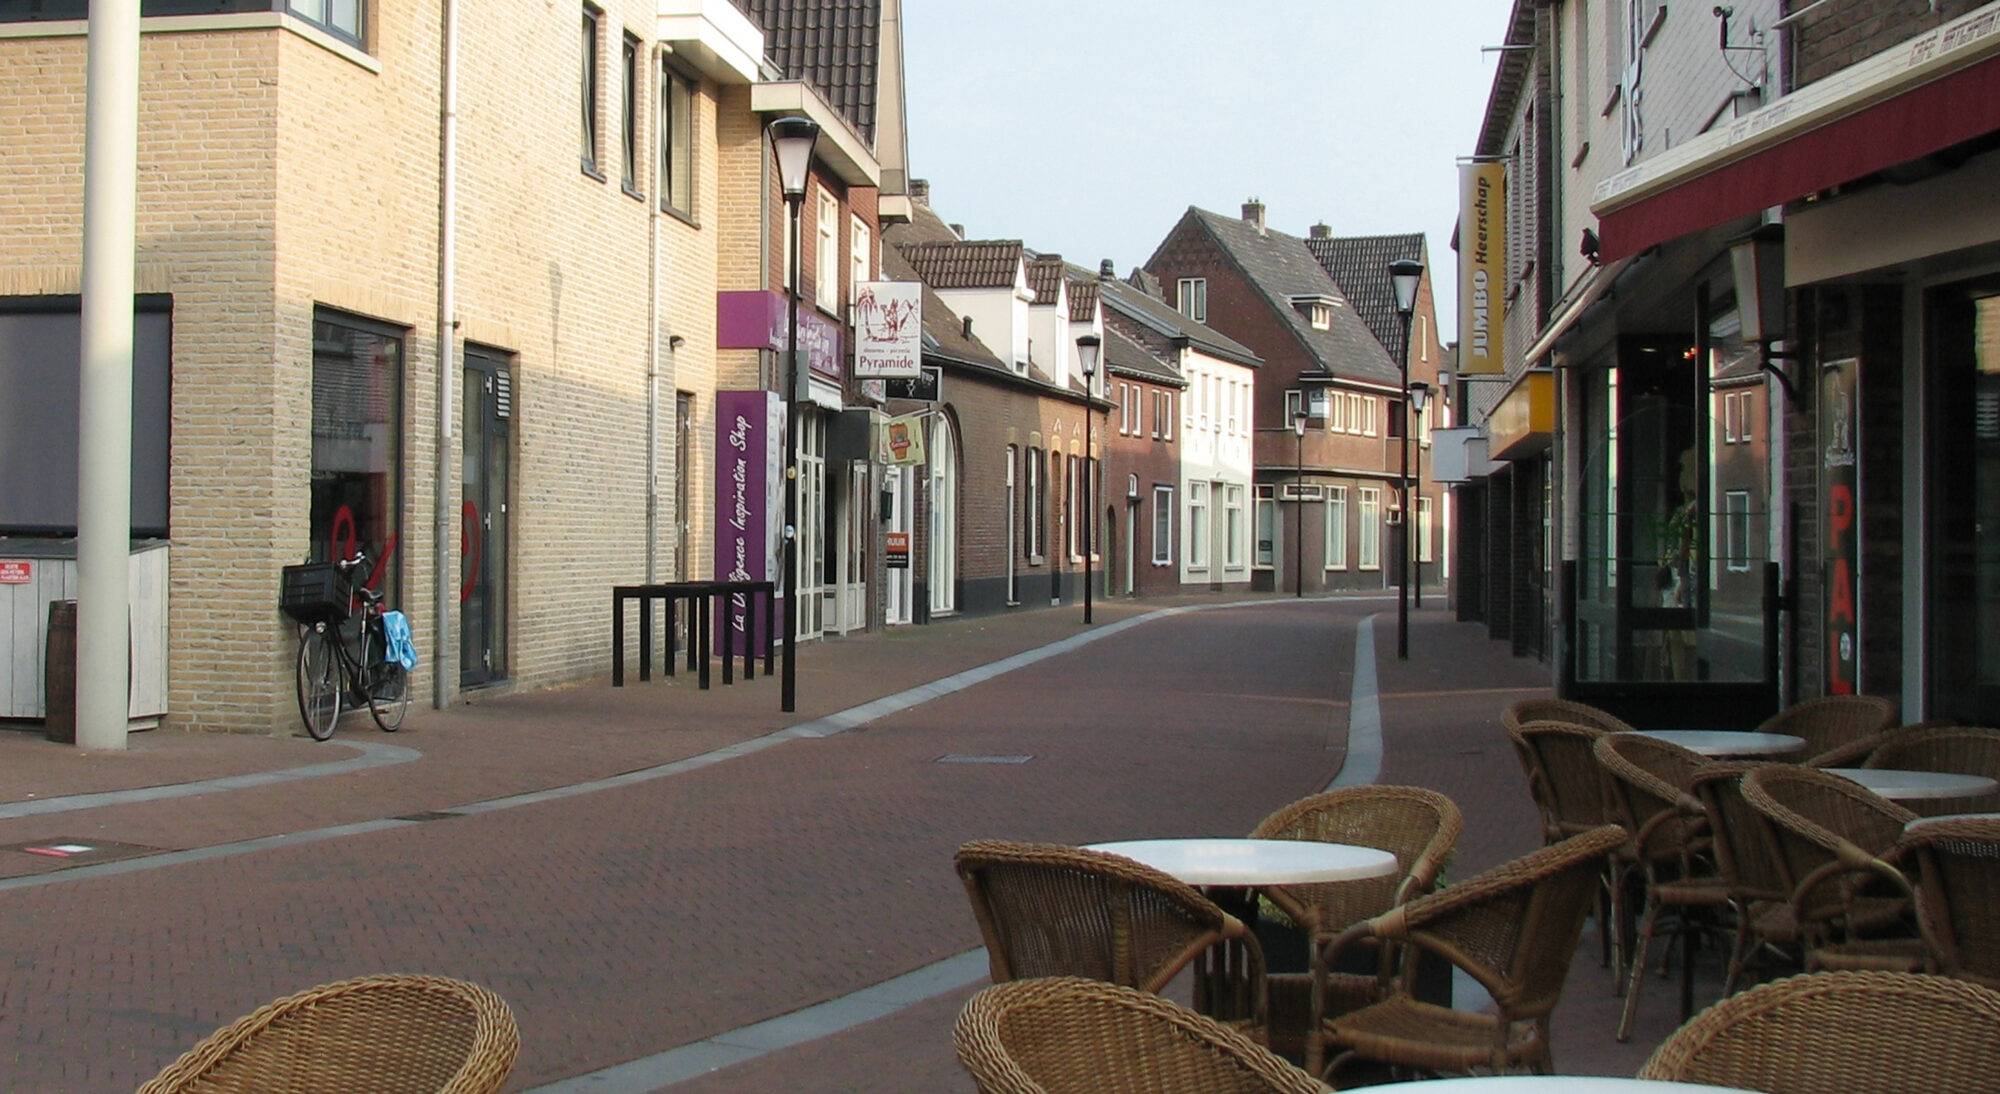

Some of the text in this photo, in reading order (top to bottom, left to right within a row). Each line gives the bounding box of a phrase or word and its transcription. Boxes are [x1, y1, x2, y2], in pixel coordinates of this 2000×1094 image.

[1473, 176, 1491, 358] JUMBO Heerschap
[860, 355, 914, 371] Pyramide
[729, 415, 752, 452] Shop
[729, 458, 752, 531] Inspiration
